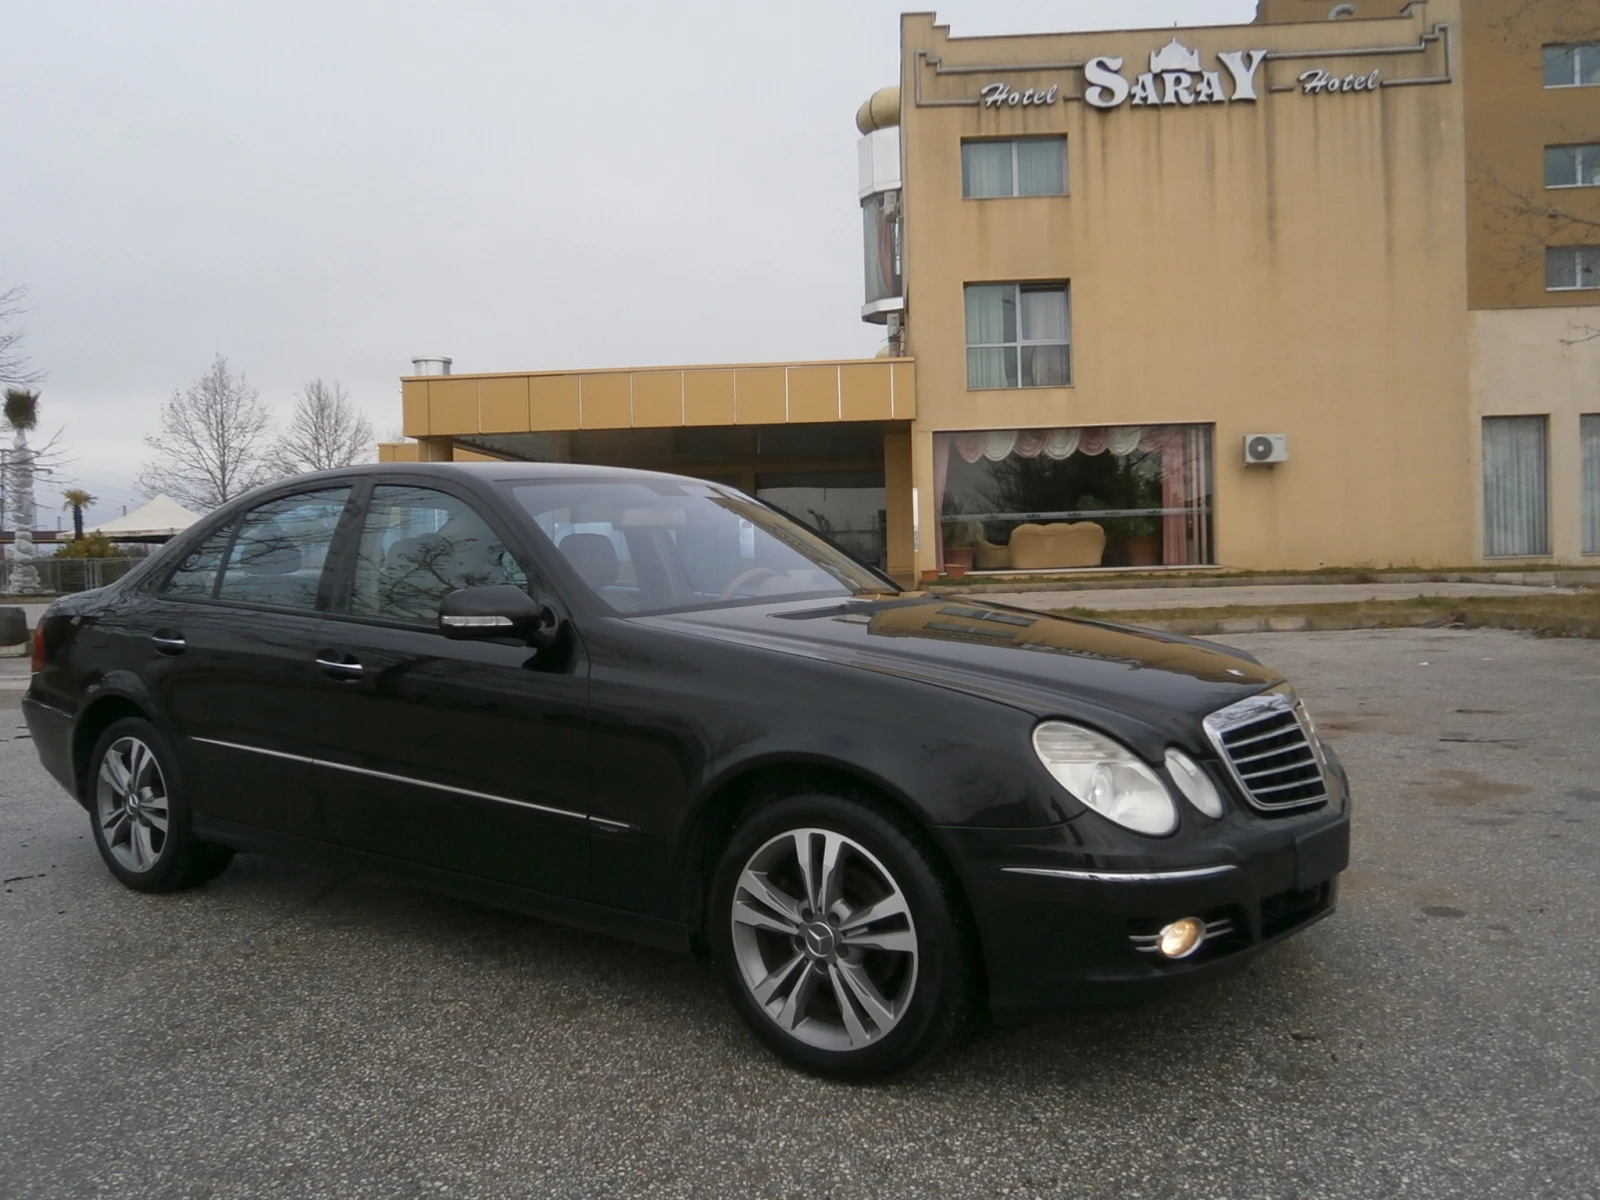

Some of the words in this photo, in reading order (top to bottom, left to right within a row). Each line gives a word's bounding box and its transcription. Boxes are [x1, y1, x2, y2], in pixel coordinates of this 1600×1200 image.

[980, 82, 1059, 107] Hotel
[1084, 49, 1267, 108] SARAY
[1298, 68, 1381, 94] Hotel
